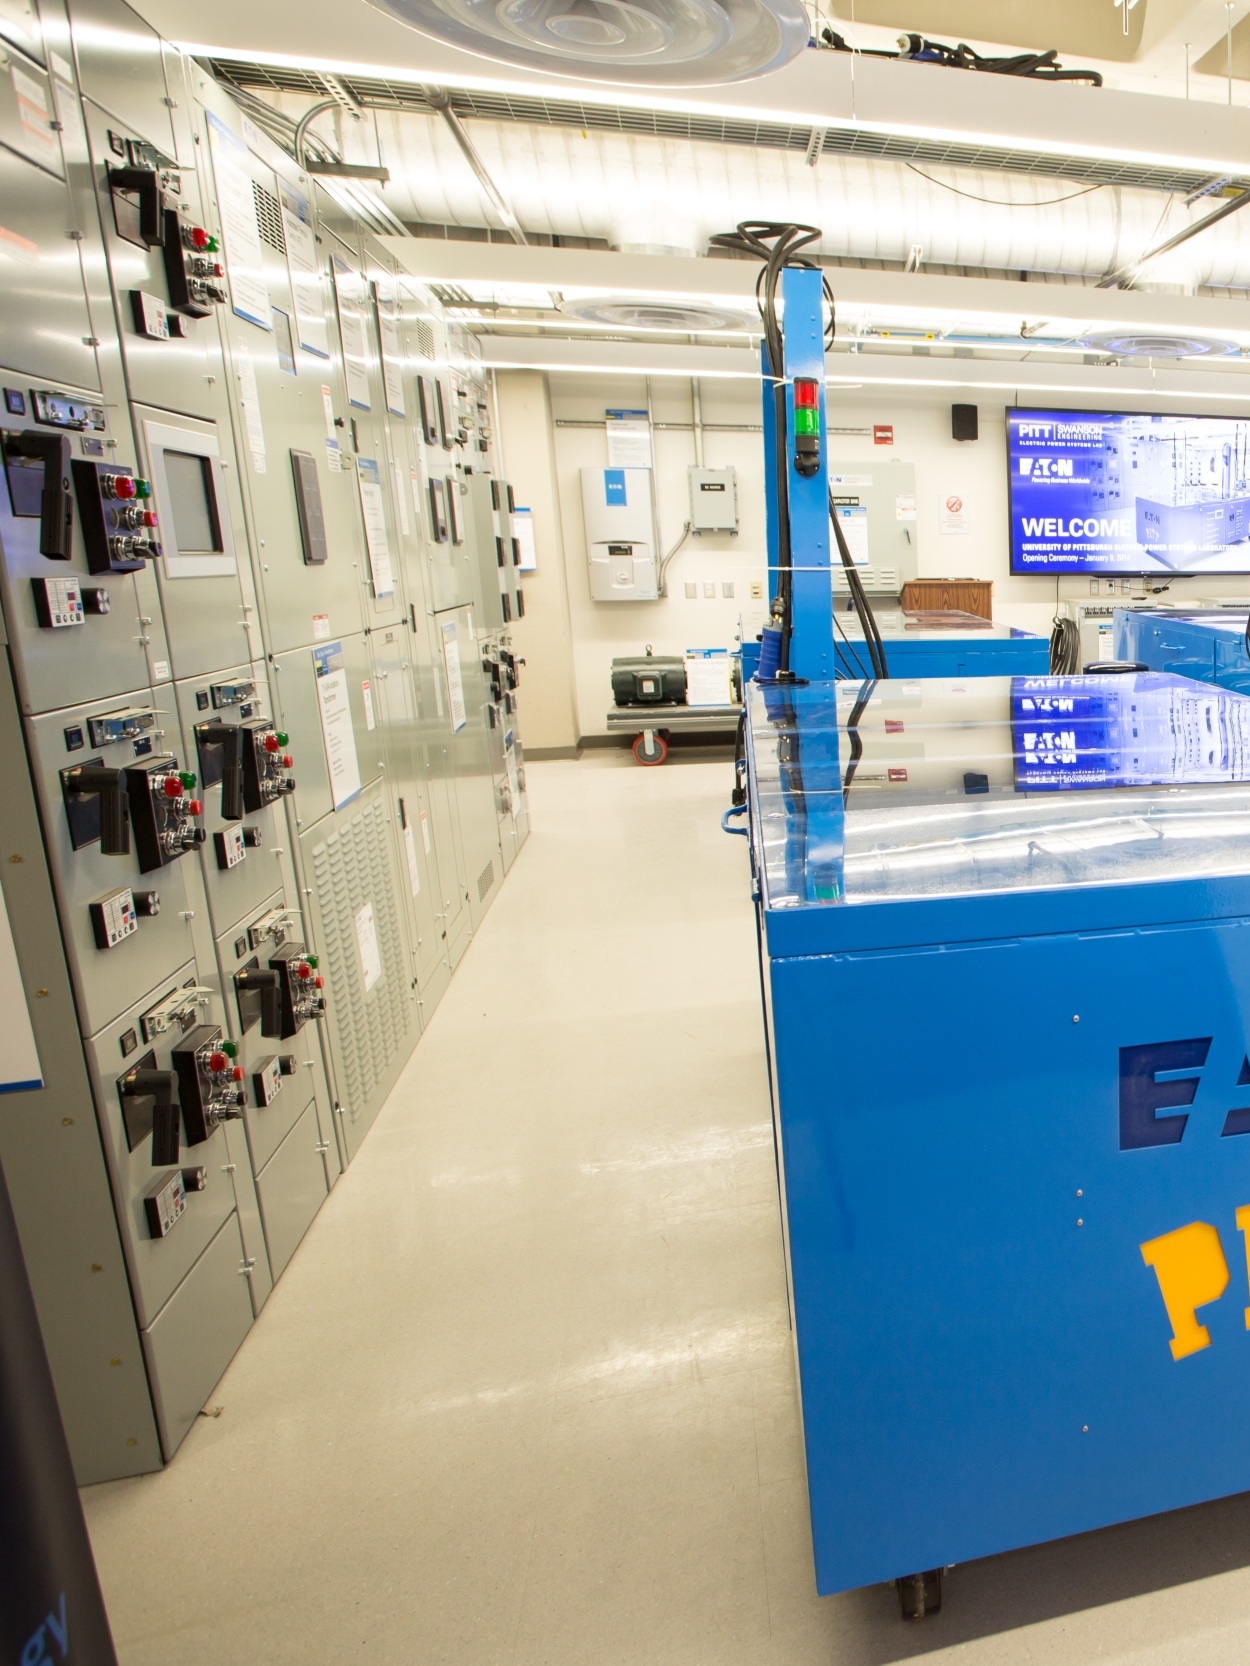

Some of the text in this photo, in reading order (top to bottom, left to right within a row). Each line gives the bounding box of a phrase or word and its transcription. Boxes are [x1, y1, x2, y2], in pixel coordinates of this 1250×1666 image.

[1019, 424, 1052, 438] PITT
[1057, 424, 1103, 434] SWANSON
[1057, 433, 1103, 441] ENGINEERING
[1019, 457, 1073, 476] EATON
[1021, 517, 1132, 538] WELCOME
[1022, 553, 1048, 563] Opening
[1049, 553, 1078, 563] Ceremony
[1085, 554, 1109, 563] January
[1116, 554, 1131, 562] 2014
